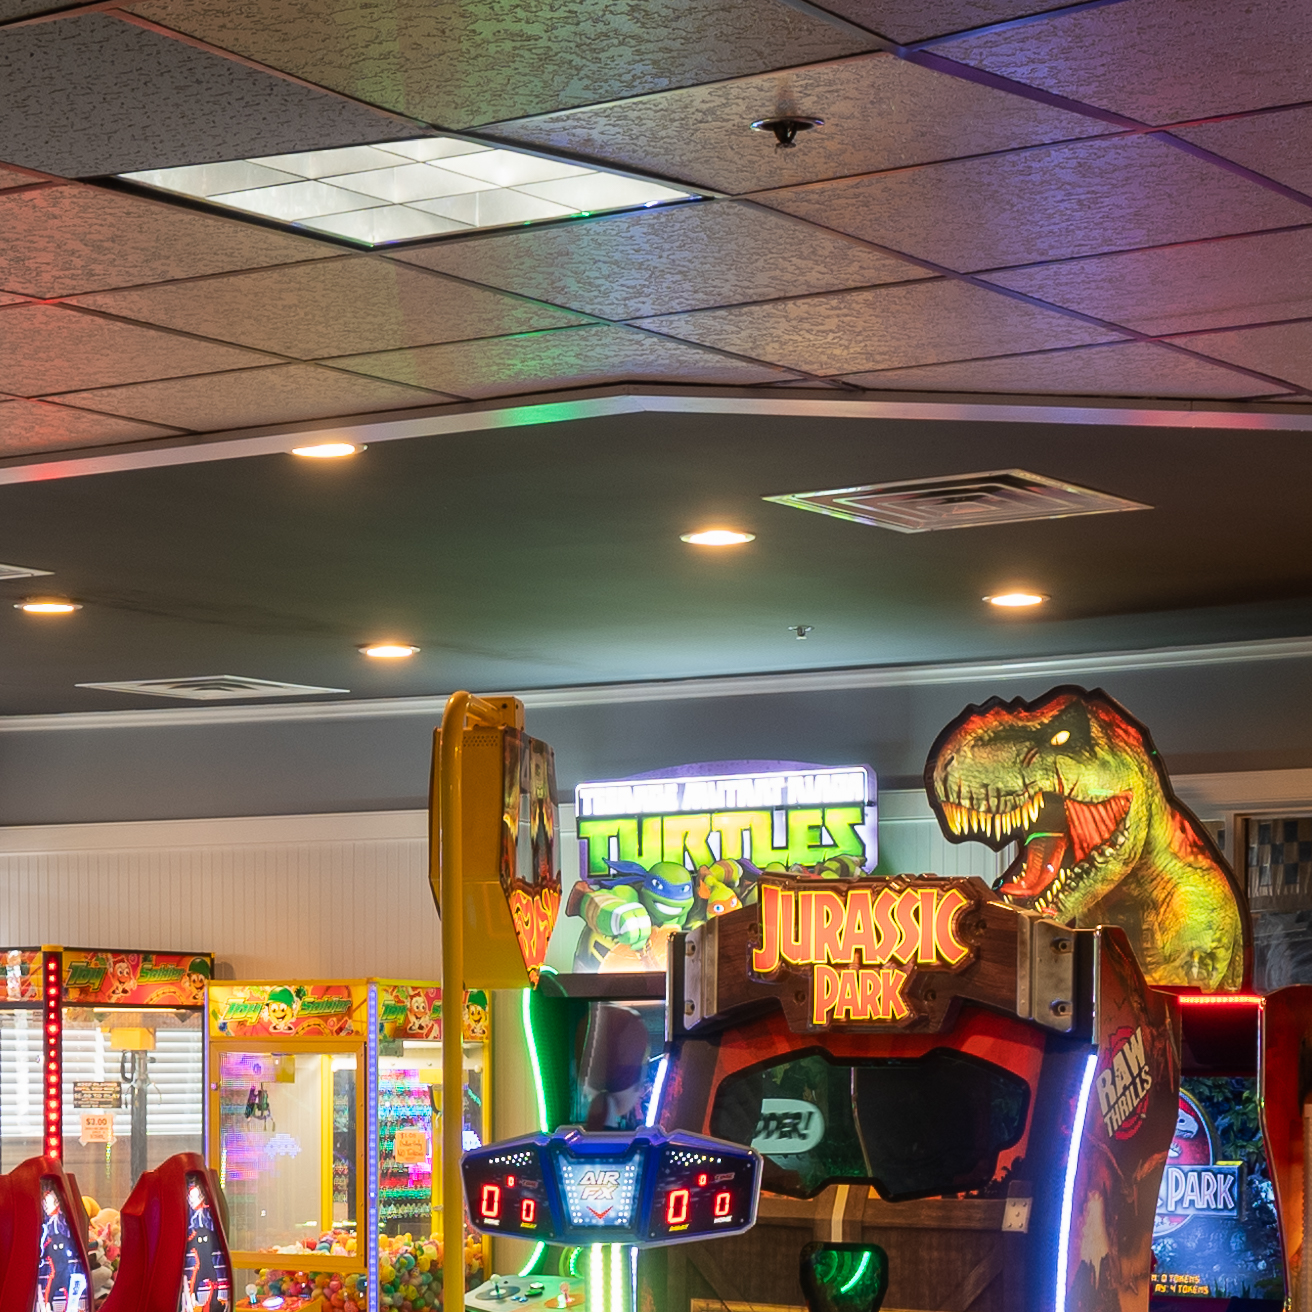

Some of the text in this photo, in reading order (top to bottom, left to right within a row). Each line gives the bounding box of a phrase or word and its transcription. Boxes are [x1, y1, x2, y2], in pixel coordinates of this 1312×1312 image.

[578, 806, 865, 877] TURTLES
[752, 884, 970, 975] JURASSIC
[63, 962, 186, 995] Toy Soldier
[813, 964, 910, 1026] PARK
[222, 996, 352, 1026] Toy Soldier
[1096, 1025, 1146, 1116] RAW
[1103, 1065, 1153, 1138] THRILLS
[580, 1170, 621, 1185] AIR
[581, 1185, 618, 1200] FX
[1166, 1165, 1235, 1212] PARK
[1169, 1275, 1201, 1284] TOKENS
[1178, 1285, 1209, 1295] TOKENS
